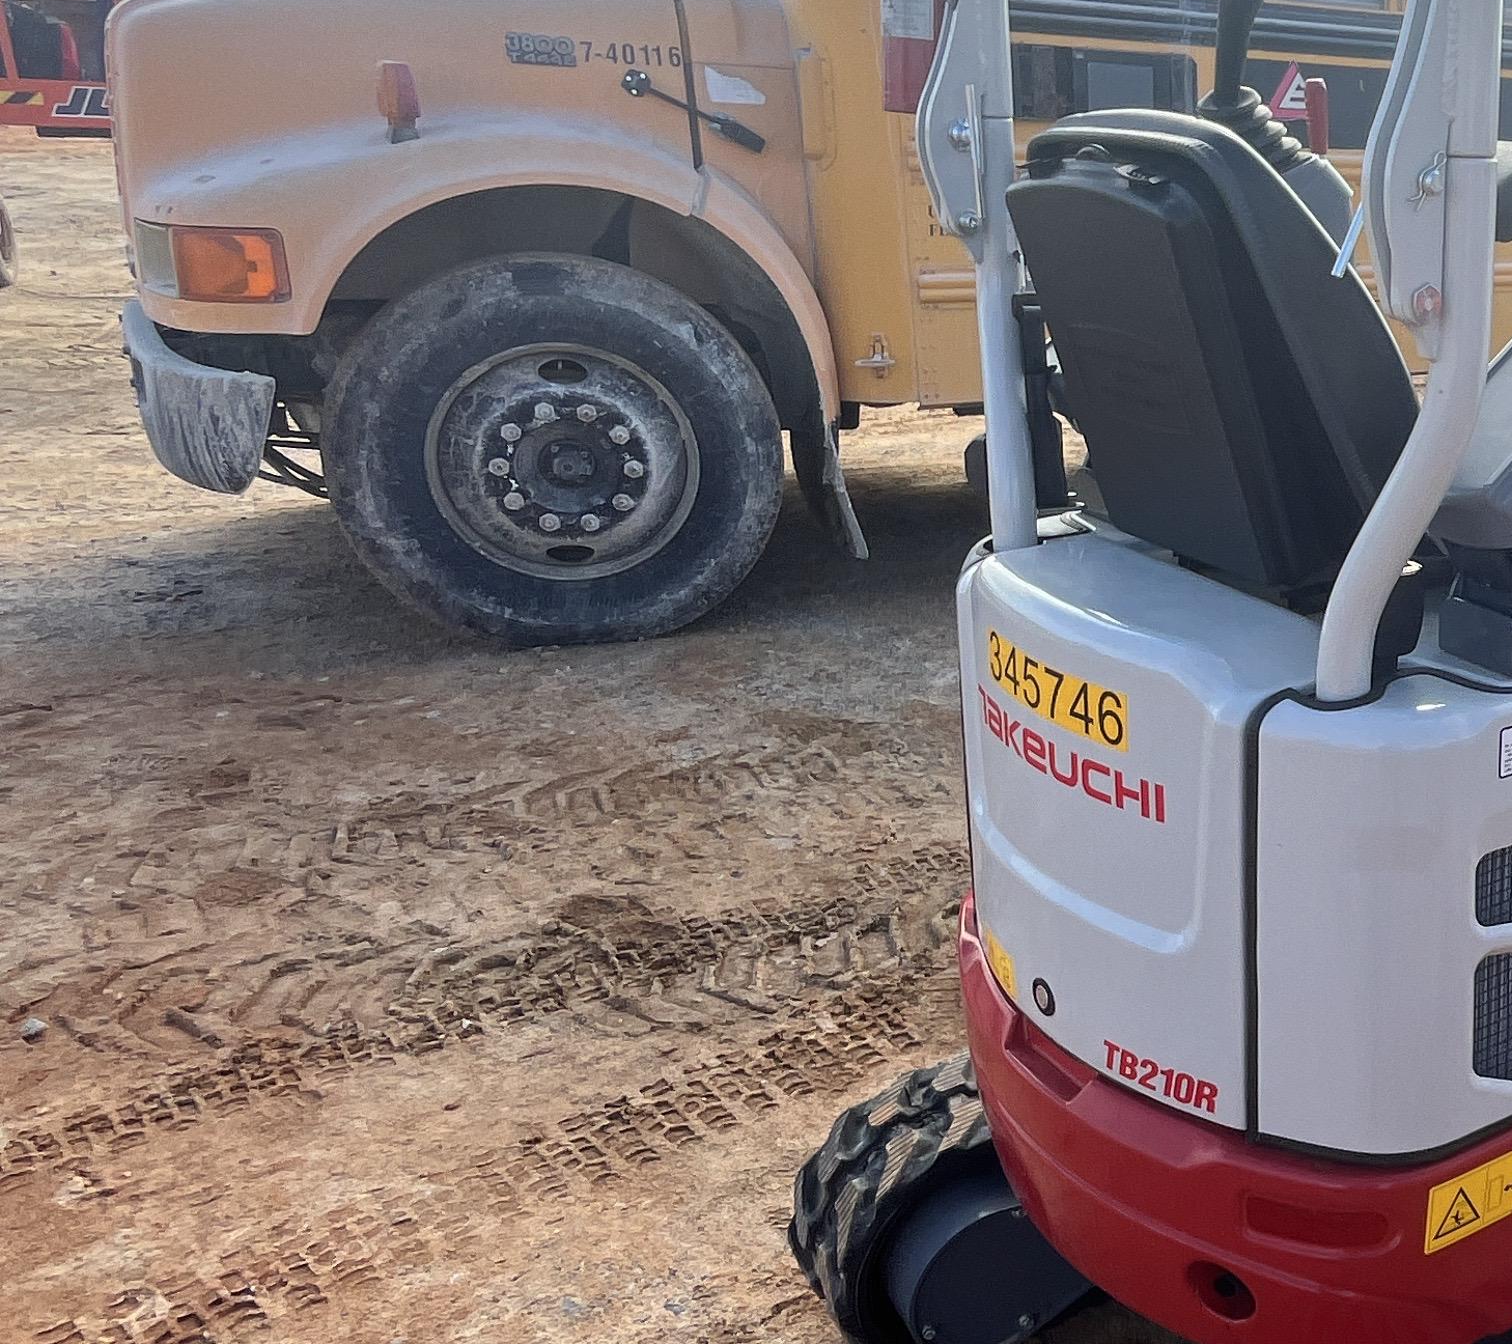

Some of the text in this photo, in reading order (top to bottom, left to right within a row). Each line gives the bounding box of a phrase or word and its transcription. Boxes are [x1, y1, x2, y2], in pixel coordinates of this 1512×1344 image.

[579, 40, 682, 68] 7-40116
[988, 630, 1124, 746] 345746
[978, 683, 1166, 824] TAKEUCHI
[1103, 1039, 1218, 1115] TB210R
